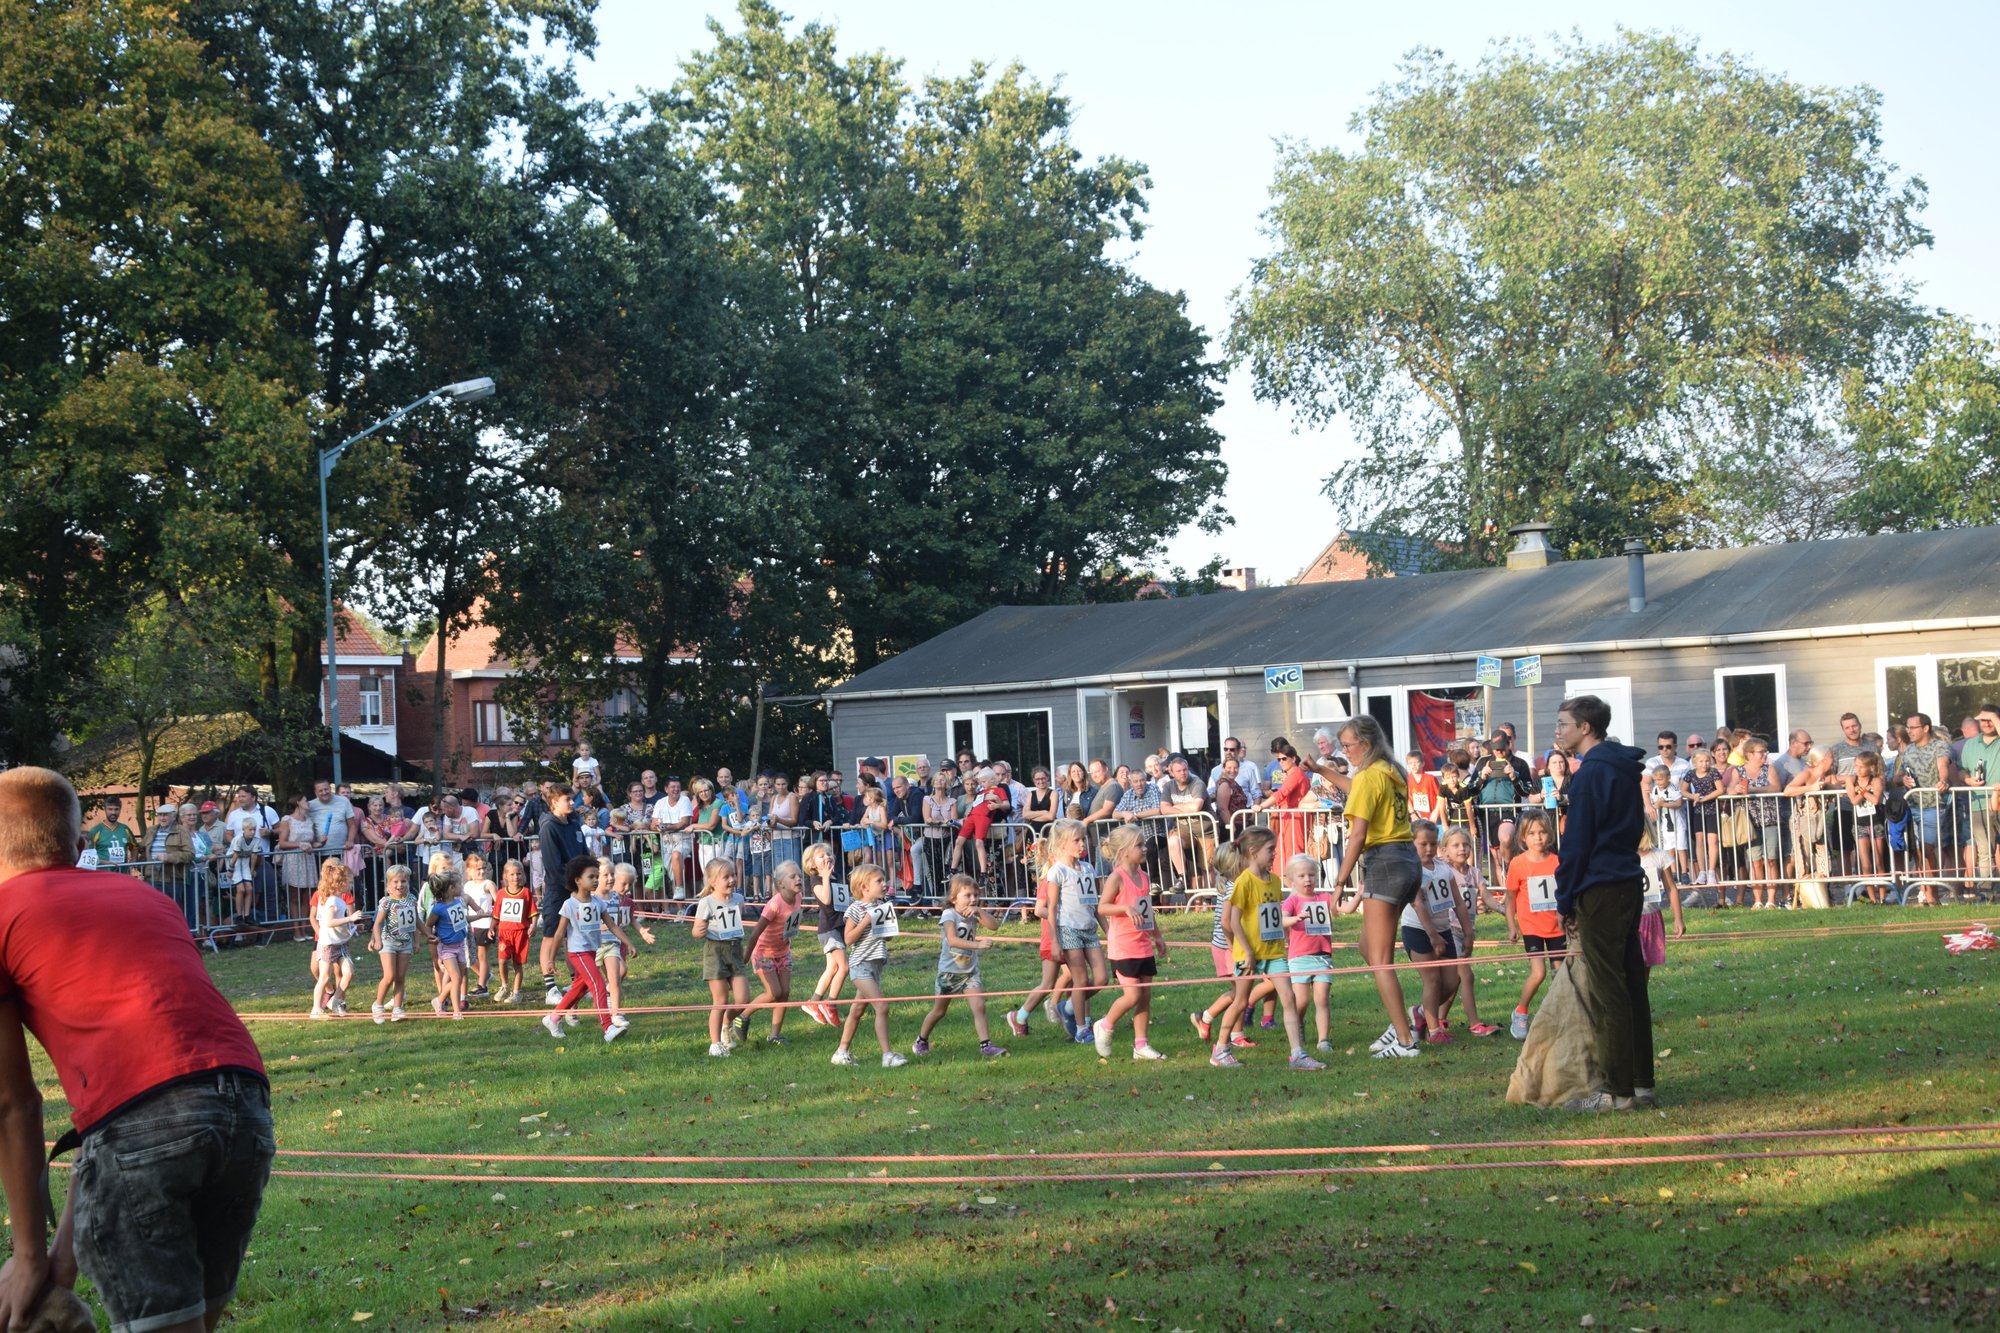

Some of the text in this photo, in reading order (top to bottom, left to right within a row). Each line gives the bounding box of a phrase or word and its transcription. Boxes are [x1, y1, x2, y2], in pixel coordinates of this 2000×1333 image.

[1269, 670, 1299, 688] WC
[1521, 672, 1536, 680] TAFEL
[82, 855, 96, 866] 136
[111, 848, 124, 857] 428
[838, 887, 846, 902] 5
[1077, 876, 1094, 895] 12
[1429, 878, 1449, 901] 18
[1538, 879, 1549, 899] 1
[400, 909, 415, 925] 13
[450, 906, 465, 924] 25
[503, 901, 521, 915] 20
[583, 906, 599, 922] 31
[874, 905, 896, 925] 24
[1139, 899, 1148, 919] 2
[1305, 905, 1326, 925] 16
[718, 910, 737, 929] 17
[786, 912, 800, 931] 14
[1261, 906, 1280, 929] 19
